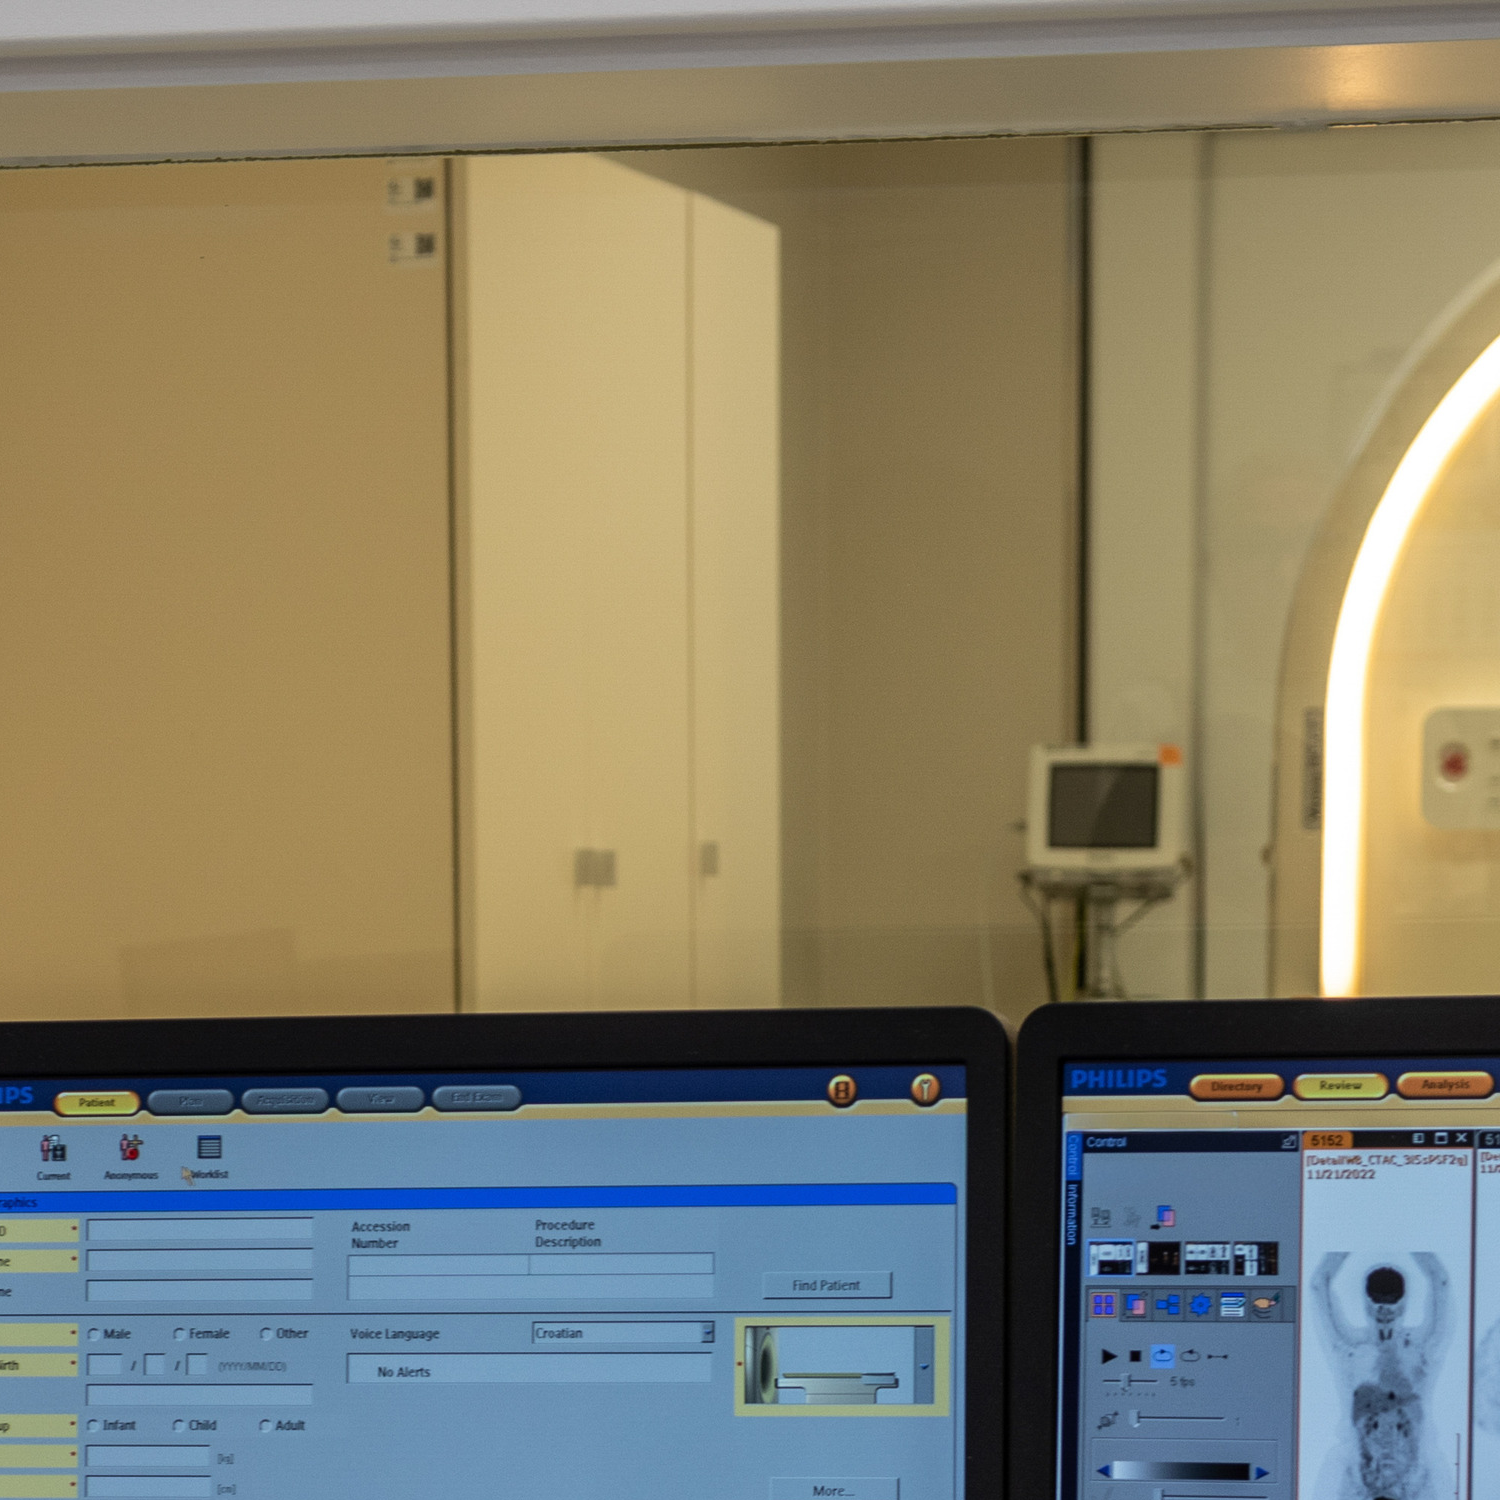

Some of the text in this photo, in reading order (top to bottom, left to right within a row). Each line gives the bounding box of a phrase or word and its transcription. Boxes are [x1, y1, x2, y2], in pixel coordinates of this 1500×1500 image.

[1071, 1069, 1167, 1089] PHILIPS
[1319, 1080, 1363, 1091] Review
[1421, 1079, 1471, 1091] Analysis
[1211, 1081, 1263, 1094] Directory
[79, 1097, 116, 1108] Patient
[1086, 1136, 1128, 1148] Control
[1310, 1134, 1343, 1147] 5152
[1067, 1135, 1079, 1175] Control
[36, 1171, 71, 1180] Current
[104, 1171, 159, 1181] Anonymous
[1307, 1169, 1377, 1180] 11/21/2022
[1066, 1184, 1079, 1246] Information
[351, 1220, 411, 1233] Accession
[535, 1219, 595, 1232] Procedure
[351, 1237, 399, 1250] Number
[535, 1235, 602, 1250] Description
[792, 1279, 861, 1292] Find Patient
[103, 1328, 131, 1340] Male
[189, 1328, 230, 1340] Female
[276, 1327, 309, 1340] Other
[350, 1328, 440, 1342] Voice Language
[535, 1327, 583, 1340] Croatian
[377, 1366, 431, 1378] No Alerts
[1179, 1376, 1196, 1389] fps
[103, 1419, 137, 1431] Infant
[188, 1419, 217, 1431] Child
[275, 1419, 305, 1432] Adult
[217, 1483, 236, 1495] [cm]
